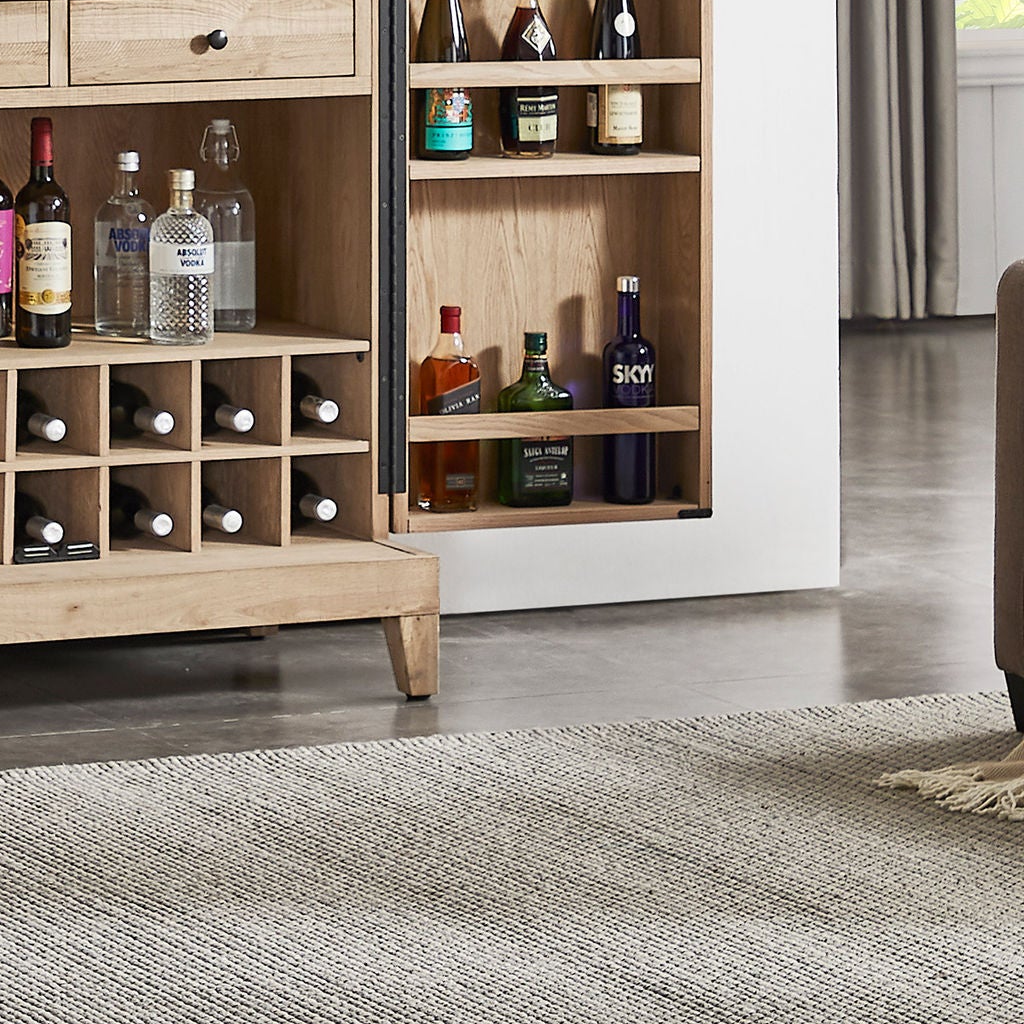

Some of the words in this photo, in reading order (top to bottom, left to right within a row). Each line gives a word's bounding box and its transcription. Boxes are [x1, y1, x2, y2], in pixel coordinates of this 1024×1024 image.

[114, 240, 150, 252] VODK
[176, 247, 207, 257] ABSOLUT
[180, 259, 205, 267] VODKA
[612, 363, 655, 385] SKYY
